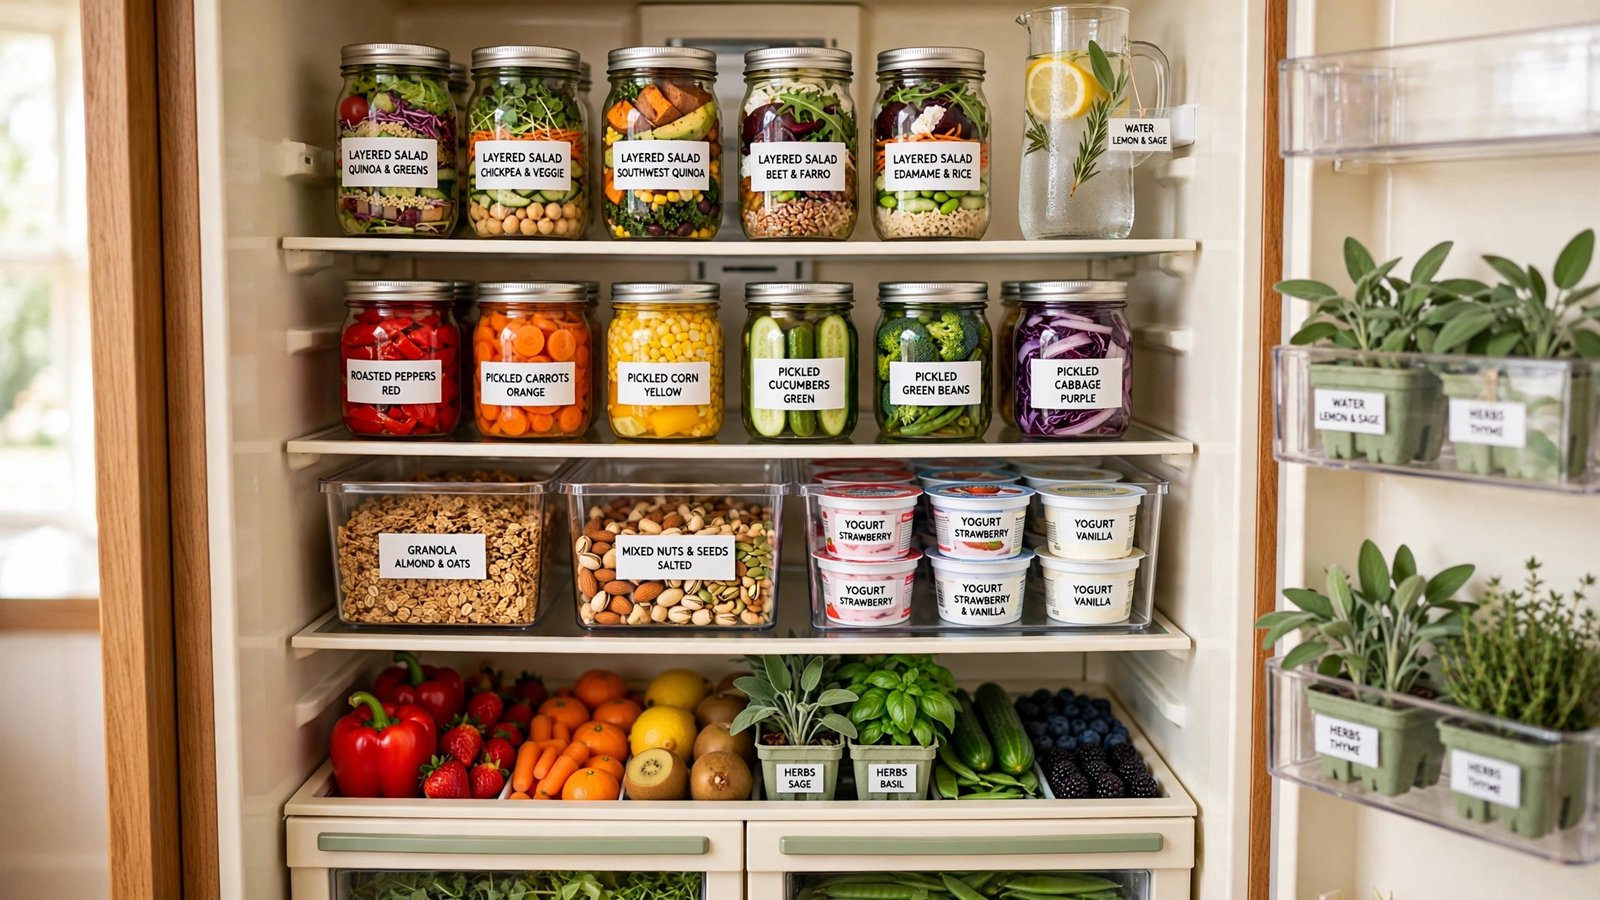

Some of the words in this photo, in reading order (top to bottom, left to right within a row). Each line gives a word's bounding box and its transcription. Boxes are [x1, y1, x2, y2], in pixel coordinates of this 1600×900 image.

[1125, 124, 1154, 132] WATER
[349, 150, 391, 160] LAYERED
[395, 150, 428, 160] SALAD
[483, 153, 525, 162] LAYERED
[529, 153, 562, 163] SALAD
[622, 153, 664, 163] LAYERED
[668, 153, 700, 163] SALAD
[759, 154, 802, 164] LAYERED
[806, 154, 837, 164] SALAD
[894, 154, 937, 164] LAYERED
[941, 154, 972, 163] SALAD
[349, 165, 381, 175] QUINOA
[384, 165, 391, 174] &
[393, 165, 428, 175] GREENS
[481, 168, 522, 177] CHICKPEA
[524, 168, 531, 177] &
[533, 168, 564, 178] VEGGIE
[618, 168, 669, 178] SOUTHWEST
[672, 168, 705, 178] QUINOA
[767, 170, 788, 179] BEET
[790, 170, 798, 179] &
[800, 169, 830, 178] FARRO
[895, 169, 940, 179] EDAMAME
[943, 169, 950, 178] &
[953, 169, 971, 178] RICE
[351, 370, 391, 381] ROASTED
[395, 372, 436, 381] PEPPERS
[779, 367, 820, 376] PICKLED
[1058, 367, 1099, 376] PICKLED
[486, 373, 522, 383] PICKLED
[526, 373, 569, 383] CARROTS
[628, 373, 667, 383] PICKLED
[671, 373, 699, 383] CORN
[916, 372, 957, 381] PICKLED
[769, 380, 830, 390] CUCUMBERS
[1055, 380, 1101, 389] CABBAGE
[382, 386, 400, 395] RED
[507, 388, 545, 397] ORANGE
[644, 387, 682, 396] YELLOW
[903, 386, 935, 395] GREEN
[938, 385, 970, 395] BEANS
[784, 394, 814, 403] GREEN
[1061, 394, 1096, 403] PURPLE
[1333, 398, 1365, 409] WATER
[1319, 412, 1348, 422] LEMON
[1358, 414, 1380, 425] SAGE
[845, 520, 885, 529] YOGURT
[961, 517, 1001, 526] YOGURT
[1075, 519, 1115, 528] YOGURT
[839, 532, 892, 541] STRAWBERRY
[955, 529, 1009, 538] STRAWBERRY
[1076, 532, 1112, 541] VANILLA
[408, 545, 457, 555] GRANOLA
[623, 547, 654, 556] MIXED
[658, 547, 683, 556] NUTS
[687, 547, 694, 556] &
[697, 547, 728, 556] SEEDS
[395, 559, 434, 568] ALMOND
[437, 559, 444, 568] &
[447, 559, 470, 568] OATS
[658, 561, 692, 569] SALTED
[846, 586, 886, 595] YOGURT
[963, 584, 1002, 593] YOGURT
[1073, 585, 1112, 594] YOGURT
[840, 597, 893, 606] STRAWBERRY
[955, 594, 1010, 605] STRAWBERRY
[1074, 597, 1111, 606] VANILLA
[961, 607, 967, 615] &
[970, 607, 1005, 616] VANILLA
[1330, 726, 1361, 741] HERBS
[1330, 739, 1360, 755] THYME
[785, 768, 815, 777] HERBS
[877, 768, 907, 776] HERBS
[789, 780, 811, 788] SAGE
[881, 780, 904, 788] BASIL
